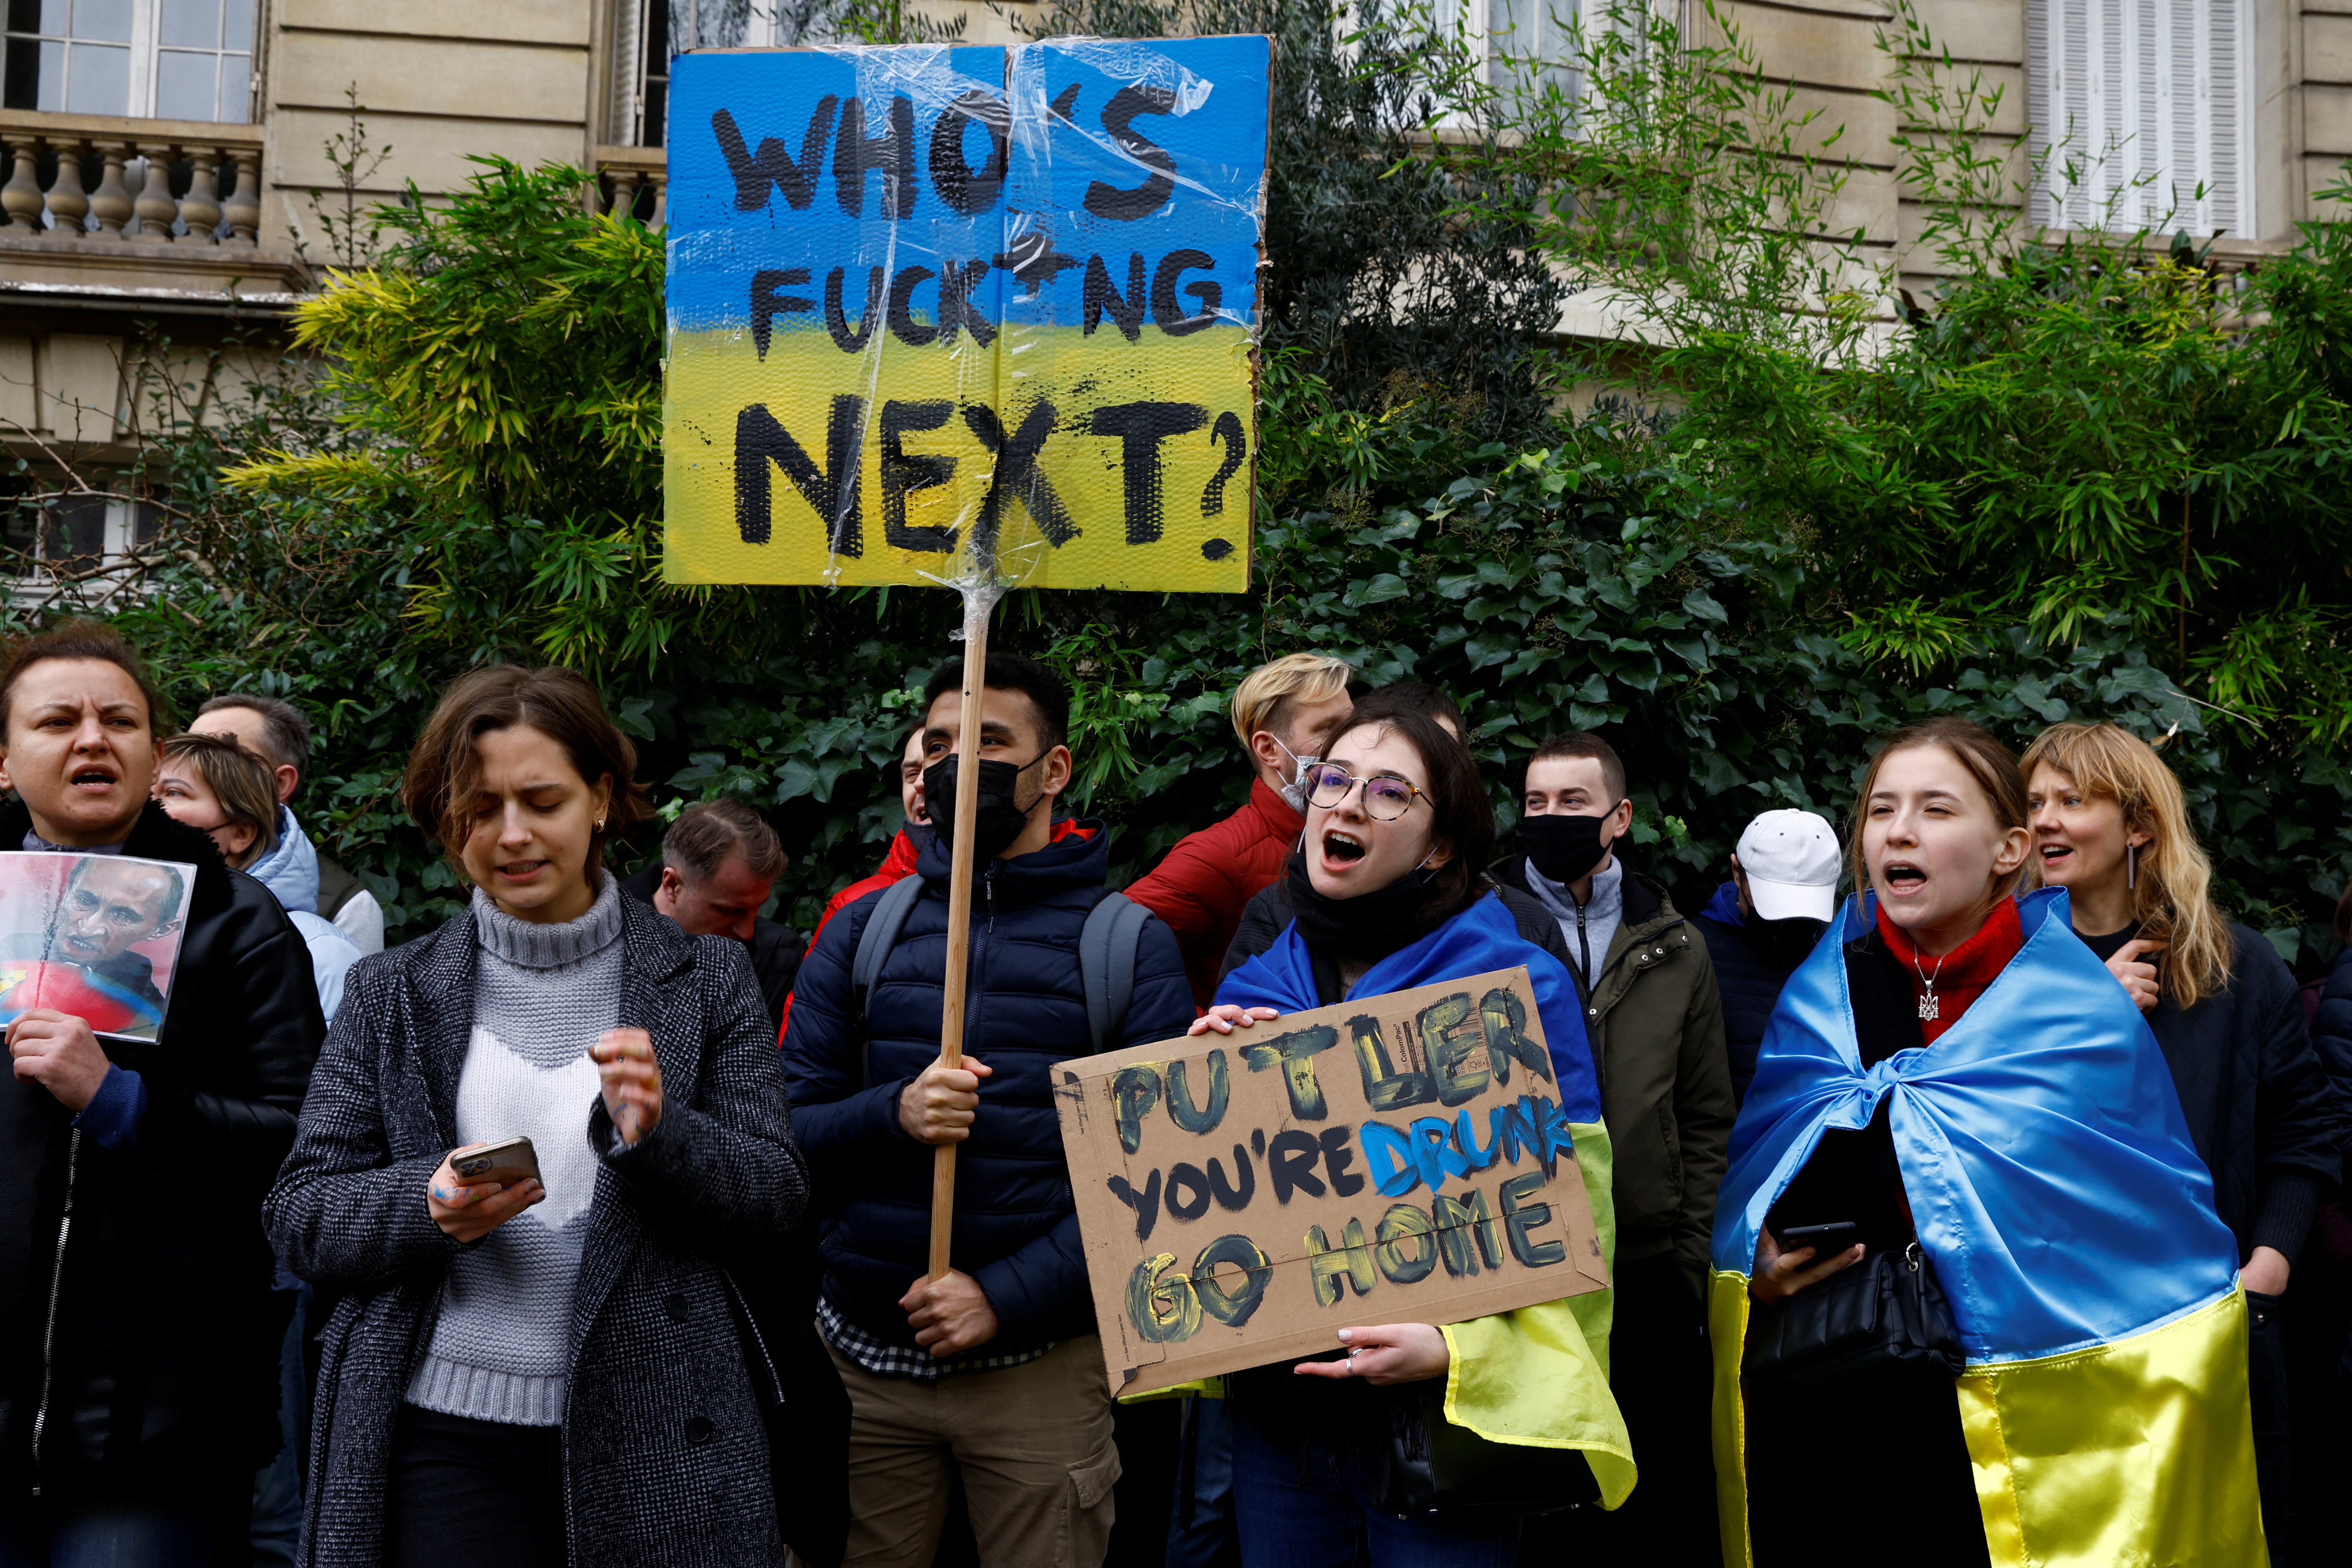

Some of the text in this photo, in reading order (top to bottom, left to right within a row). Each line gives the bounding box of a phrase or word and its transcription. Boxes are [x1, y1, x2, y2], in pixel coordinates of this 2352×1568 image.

[711, 82, 1177, 222] WHO'S
[733, 393, 1246, 568] NEXT?
[1107, 1093, 1574, 1241] YOU'RE DRUNK
[1125, 1171, 1567, 1343] GO HOME
